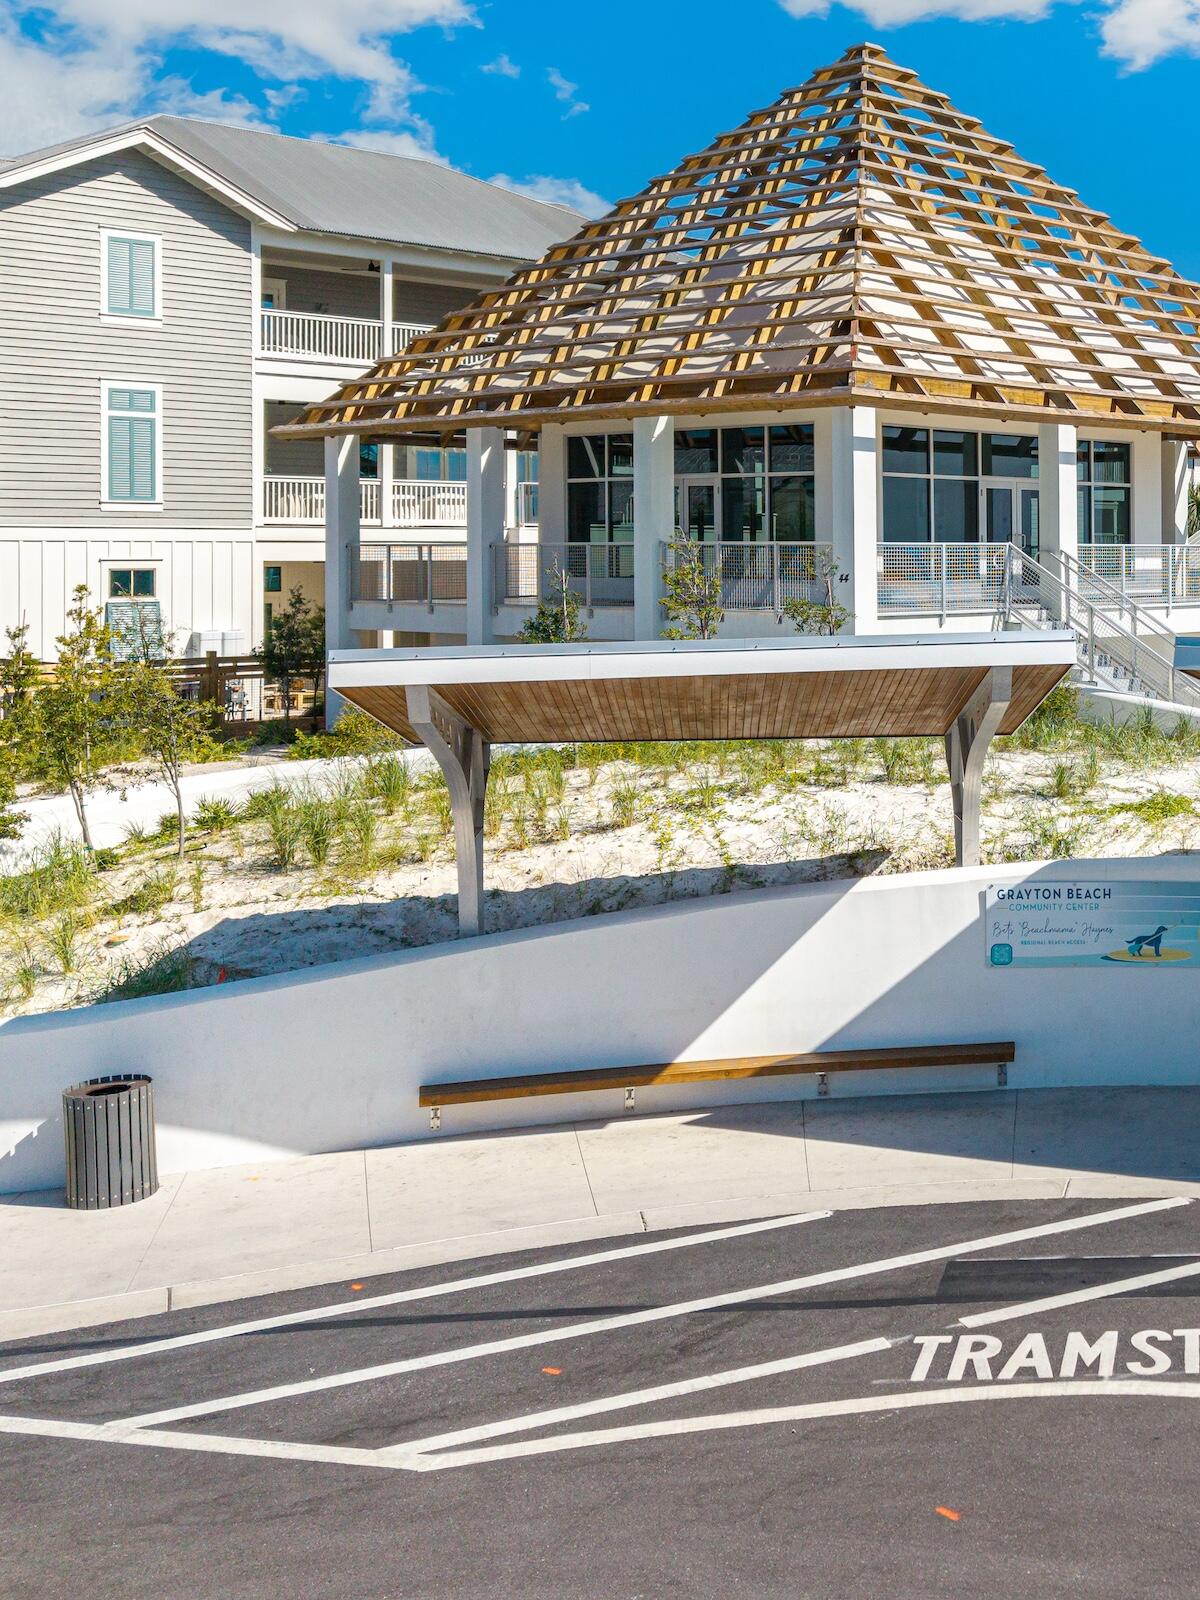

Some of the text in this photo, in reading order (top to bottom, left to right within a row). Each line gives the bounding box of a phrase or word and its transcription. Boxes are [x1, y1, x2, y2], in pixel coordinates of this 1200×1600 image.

[997, 887, 1111, 900] GRAYTON BEACH
[1008, 902, 1100, 911] COMMUNITY CENTER
[1081, 921, 1114, 943] Haynes
[910, 1330, 1119, 1382] TRAM
